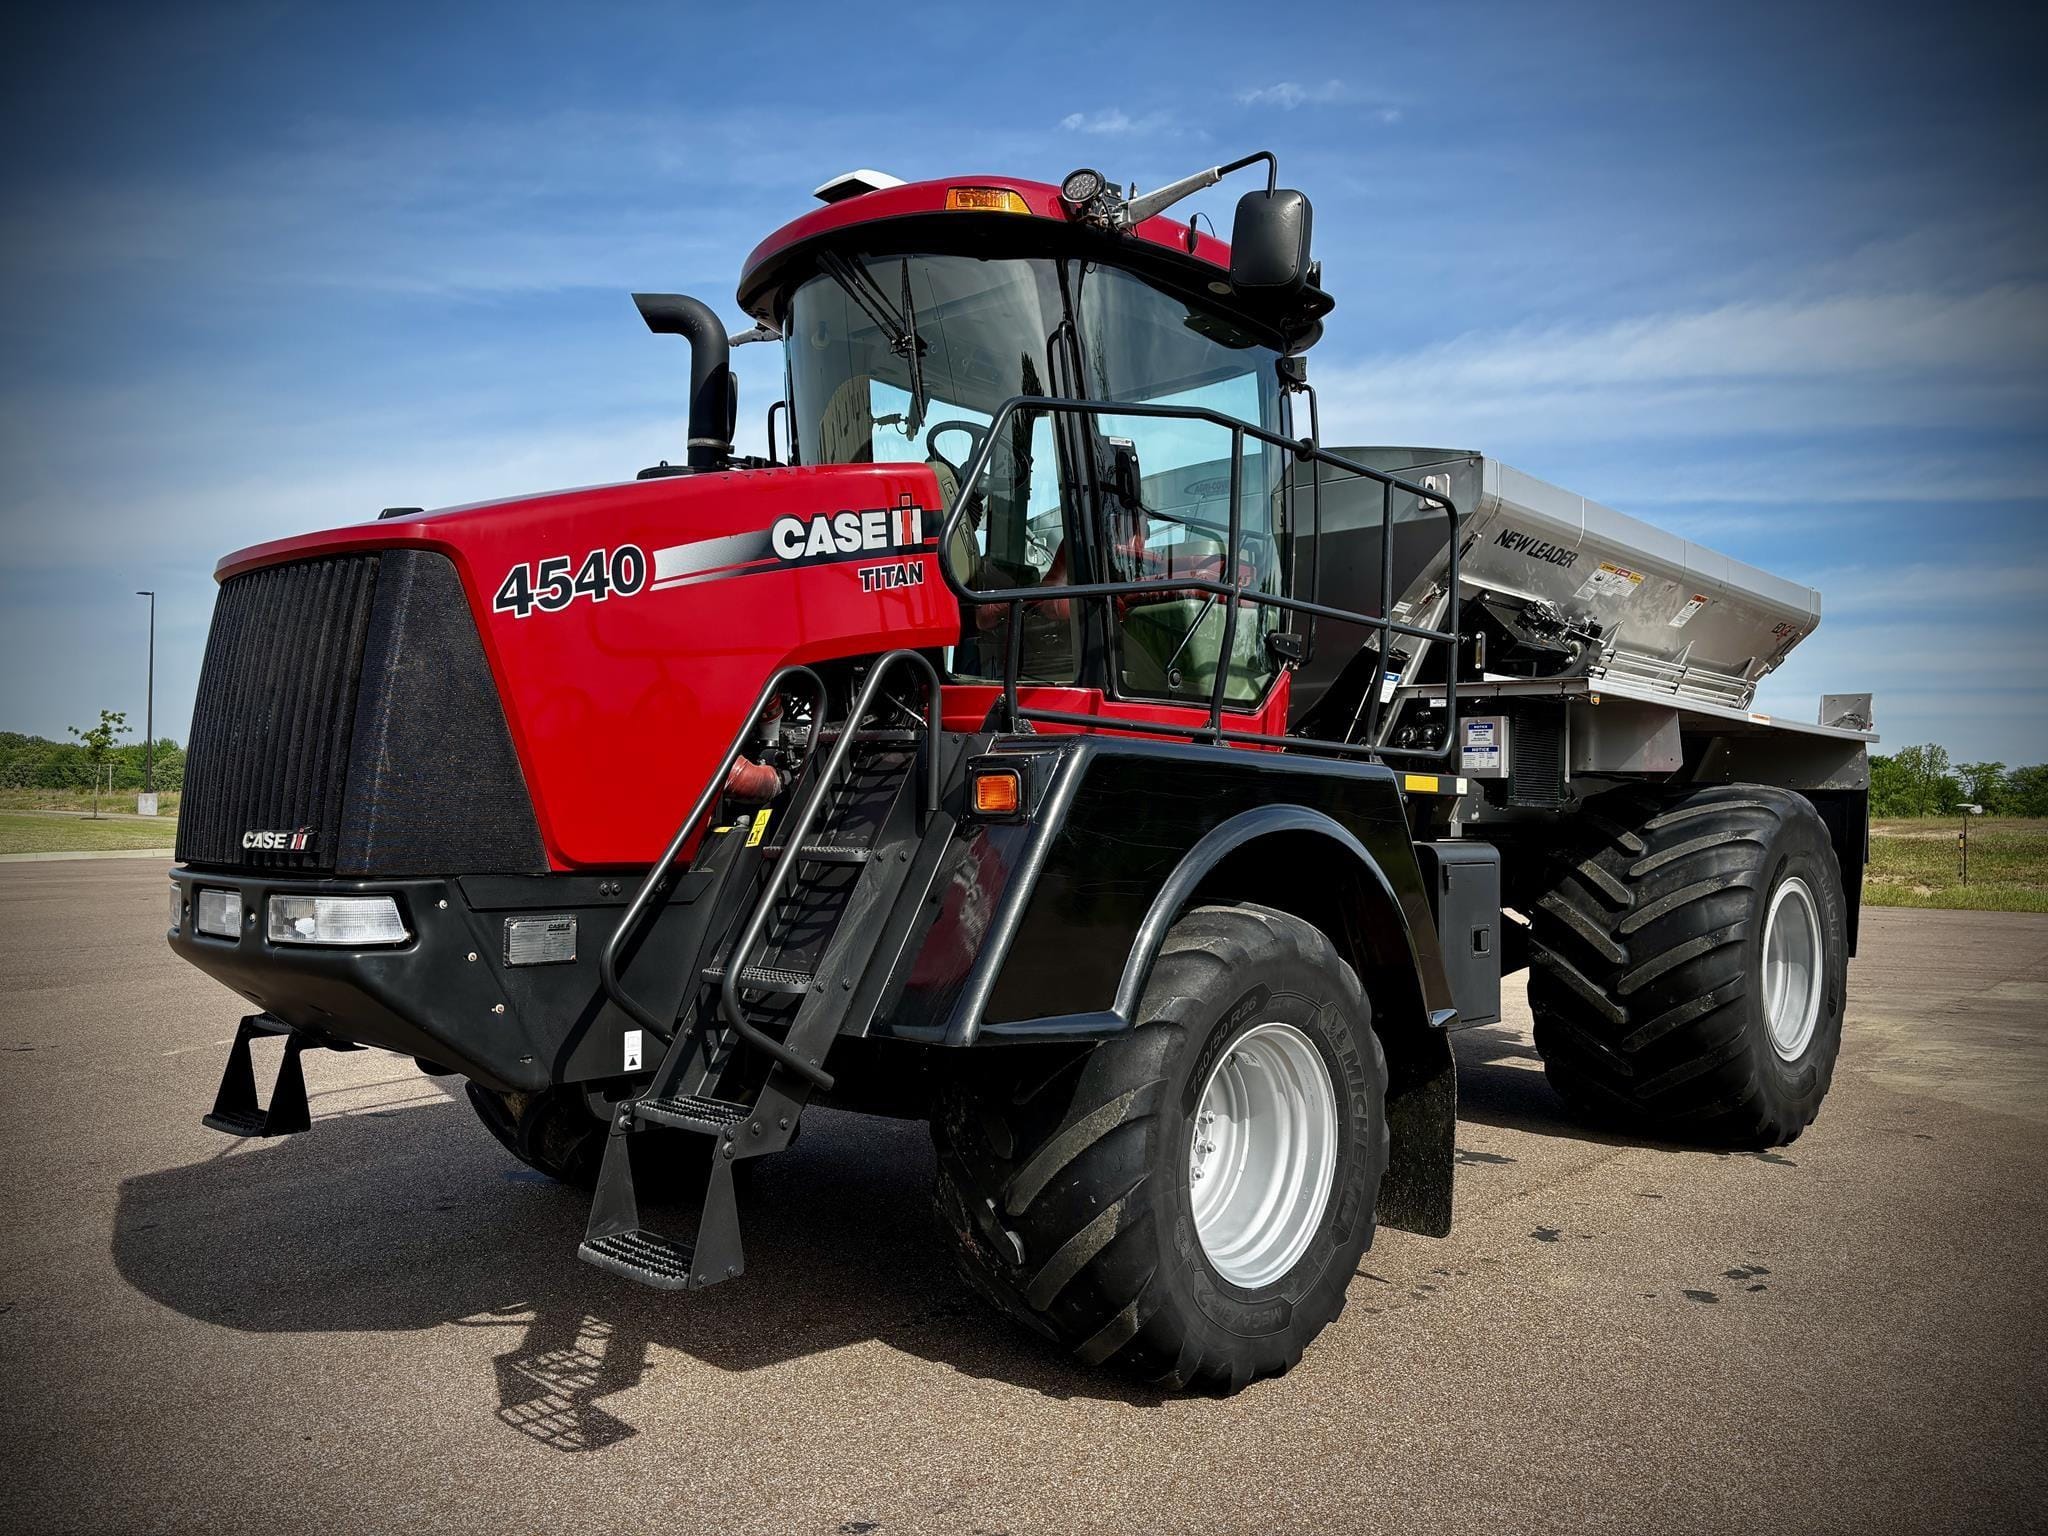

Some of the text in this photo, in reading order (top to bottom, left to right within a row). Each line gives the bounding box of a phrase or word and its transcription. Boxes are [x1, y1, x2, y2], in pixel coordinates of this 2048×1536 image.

[772, 513, 887, 560] CASE
[1494, 529, 1579, 568] NEW LEADER
[493, 543, 647, 619] 4540
[858, 561, 923, 592] TITAN
[242, 831, 288, 849] CASE
